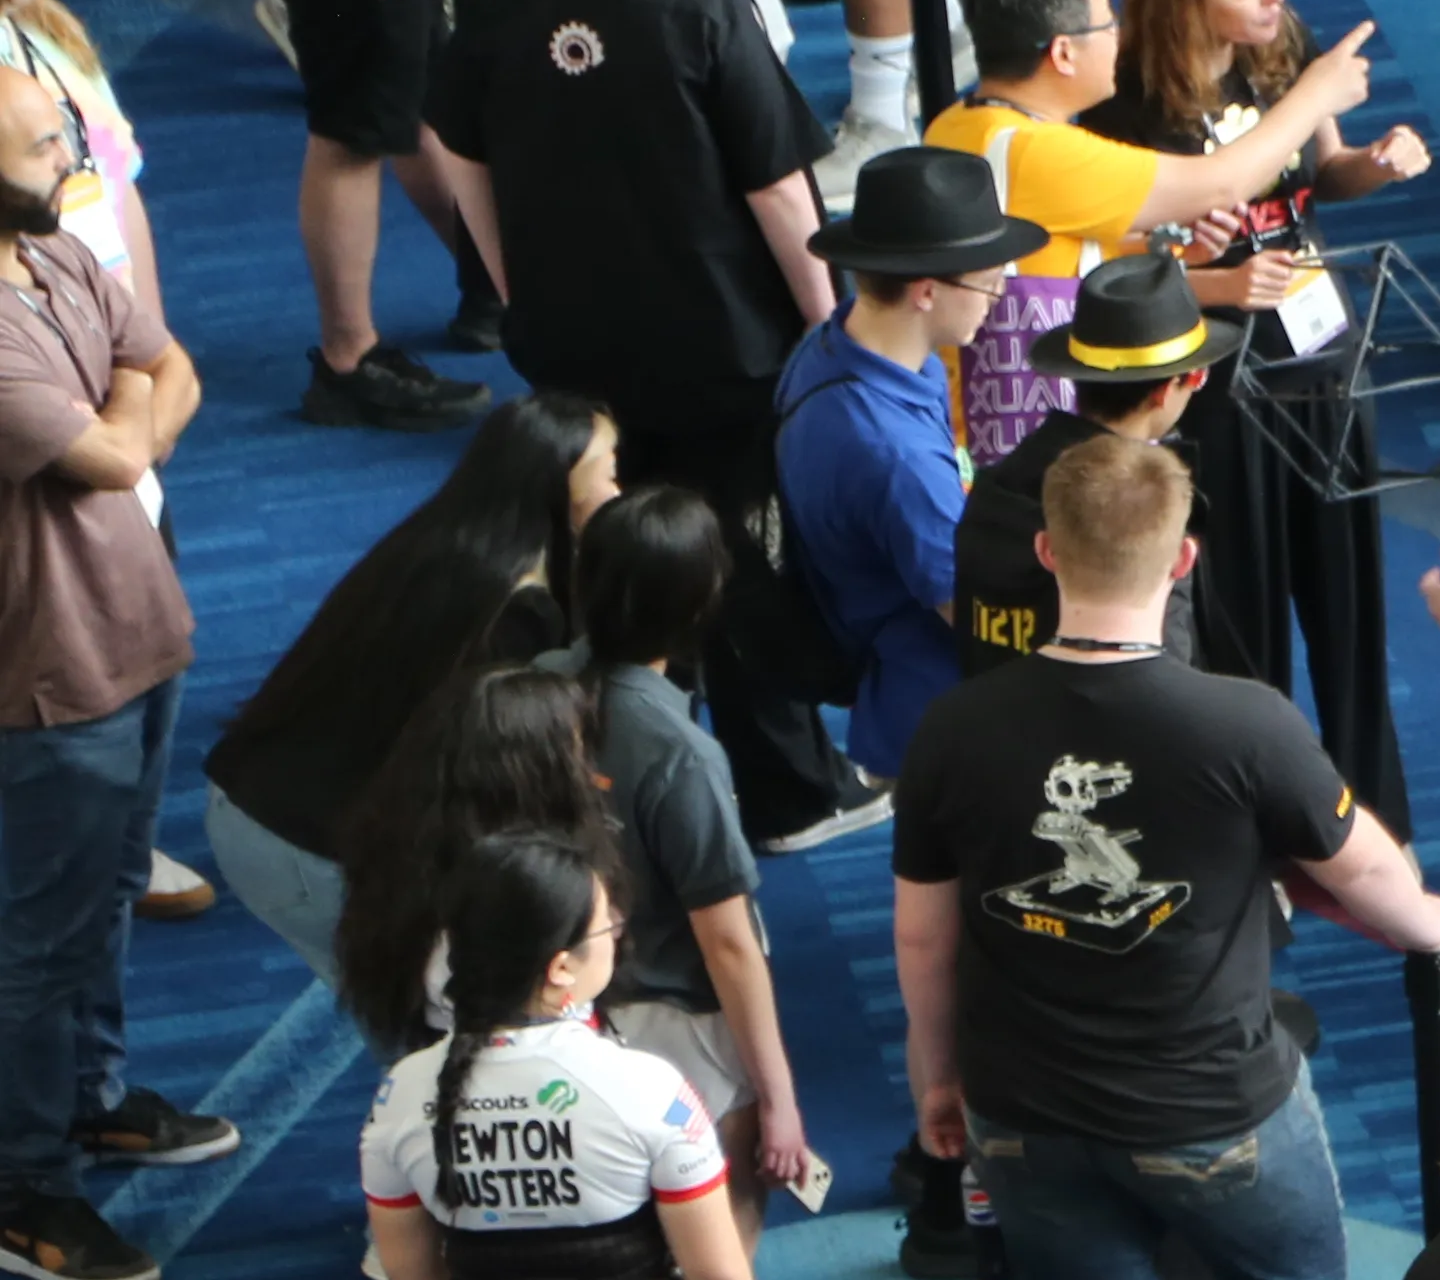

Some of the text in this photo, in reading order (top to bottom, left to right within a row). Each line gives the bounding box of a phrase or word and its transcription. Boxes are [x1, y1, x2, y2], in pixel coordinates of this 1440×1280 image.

[982, 295, 1076, 333] UAN
[446, 1120, 575, 1164] EWTON
[452, 1167, 582, 1209] USTERS
